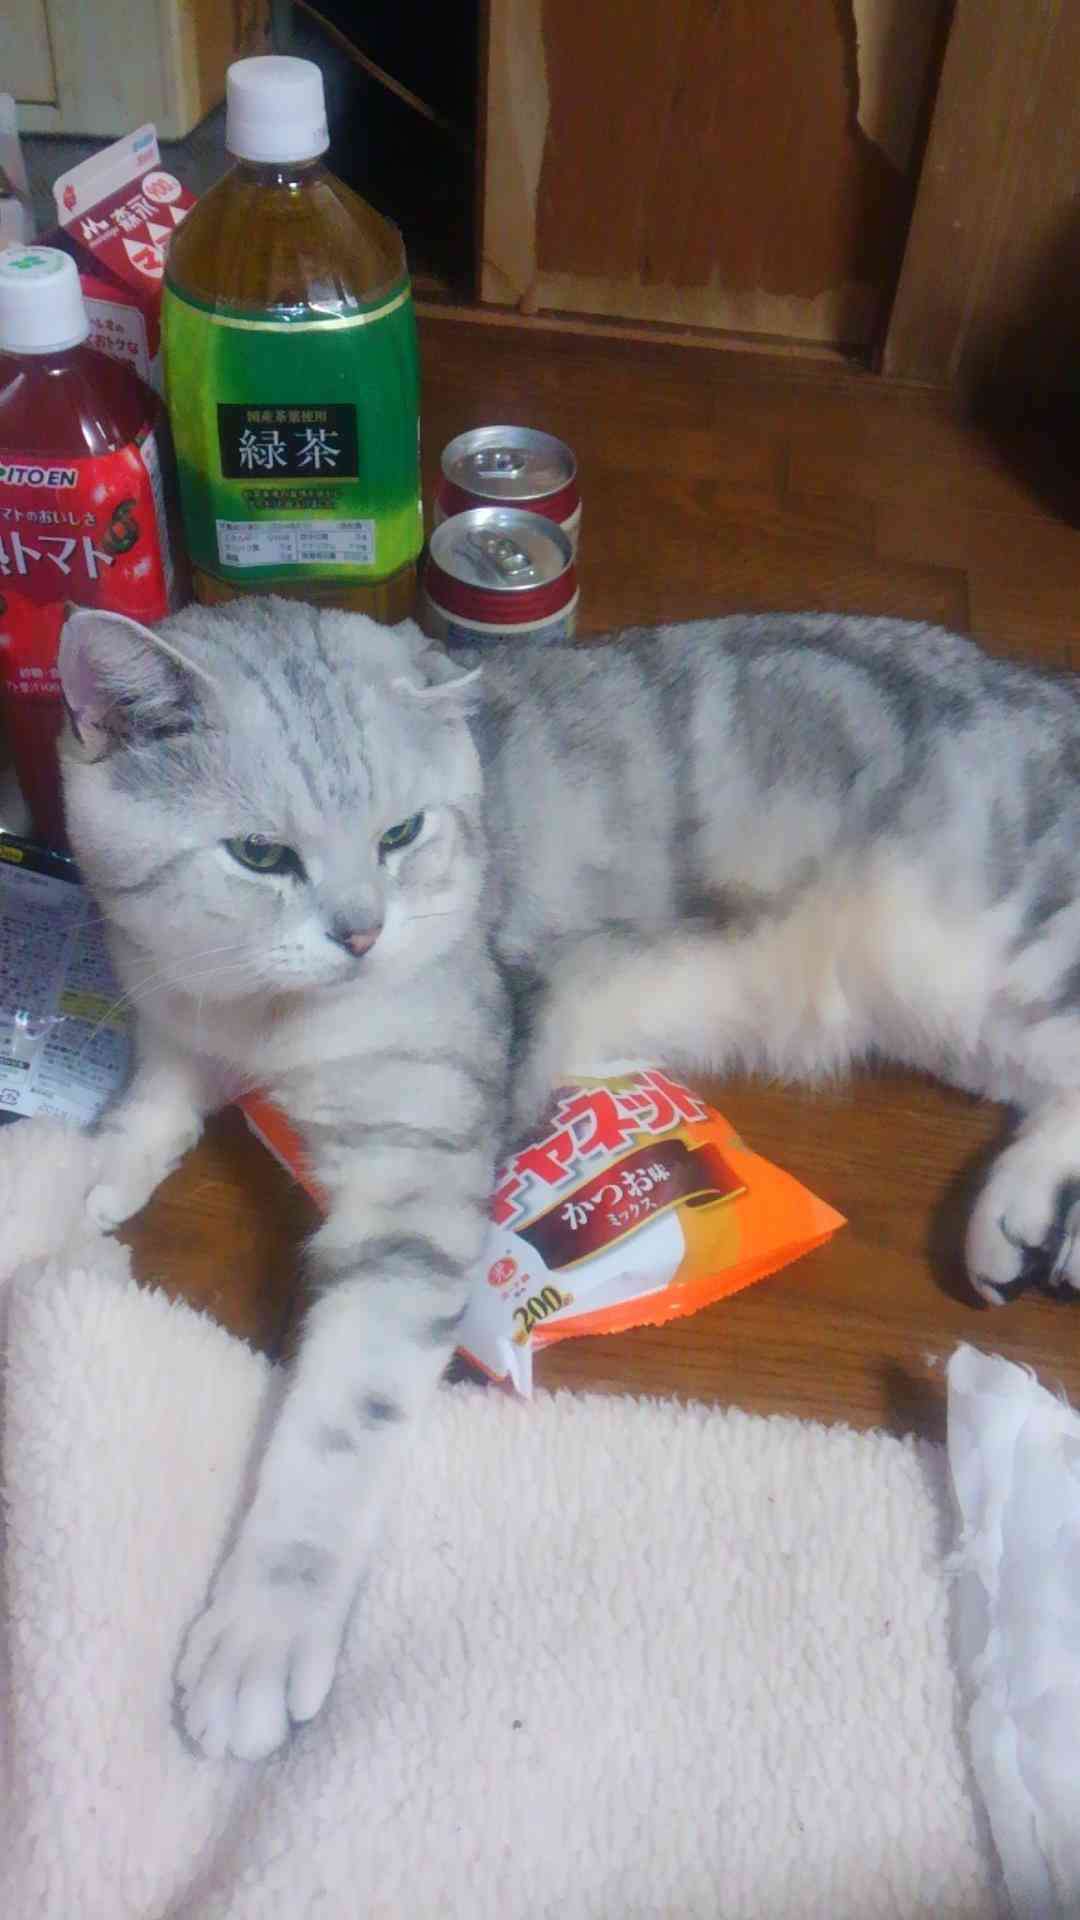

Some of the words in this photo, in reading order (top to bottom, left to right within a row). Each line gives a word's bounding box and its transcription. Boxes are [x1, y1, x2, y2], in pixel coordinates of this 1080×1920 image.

[239, 428, 341, 470] 緑茶
[0, 530, 115, 580] トマト
[561, 1163, 671, 1231] かつお味
[606, 1197, 657, 1227] ミックス
[513, 1287, 562, 1335] 200
